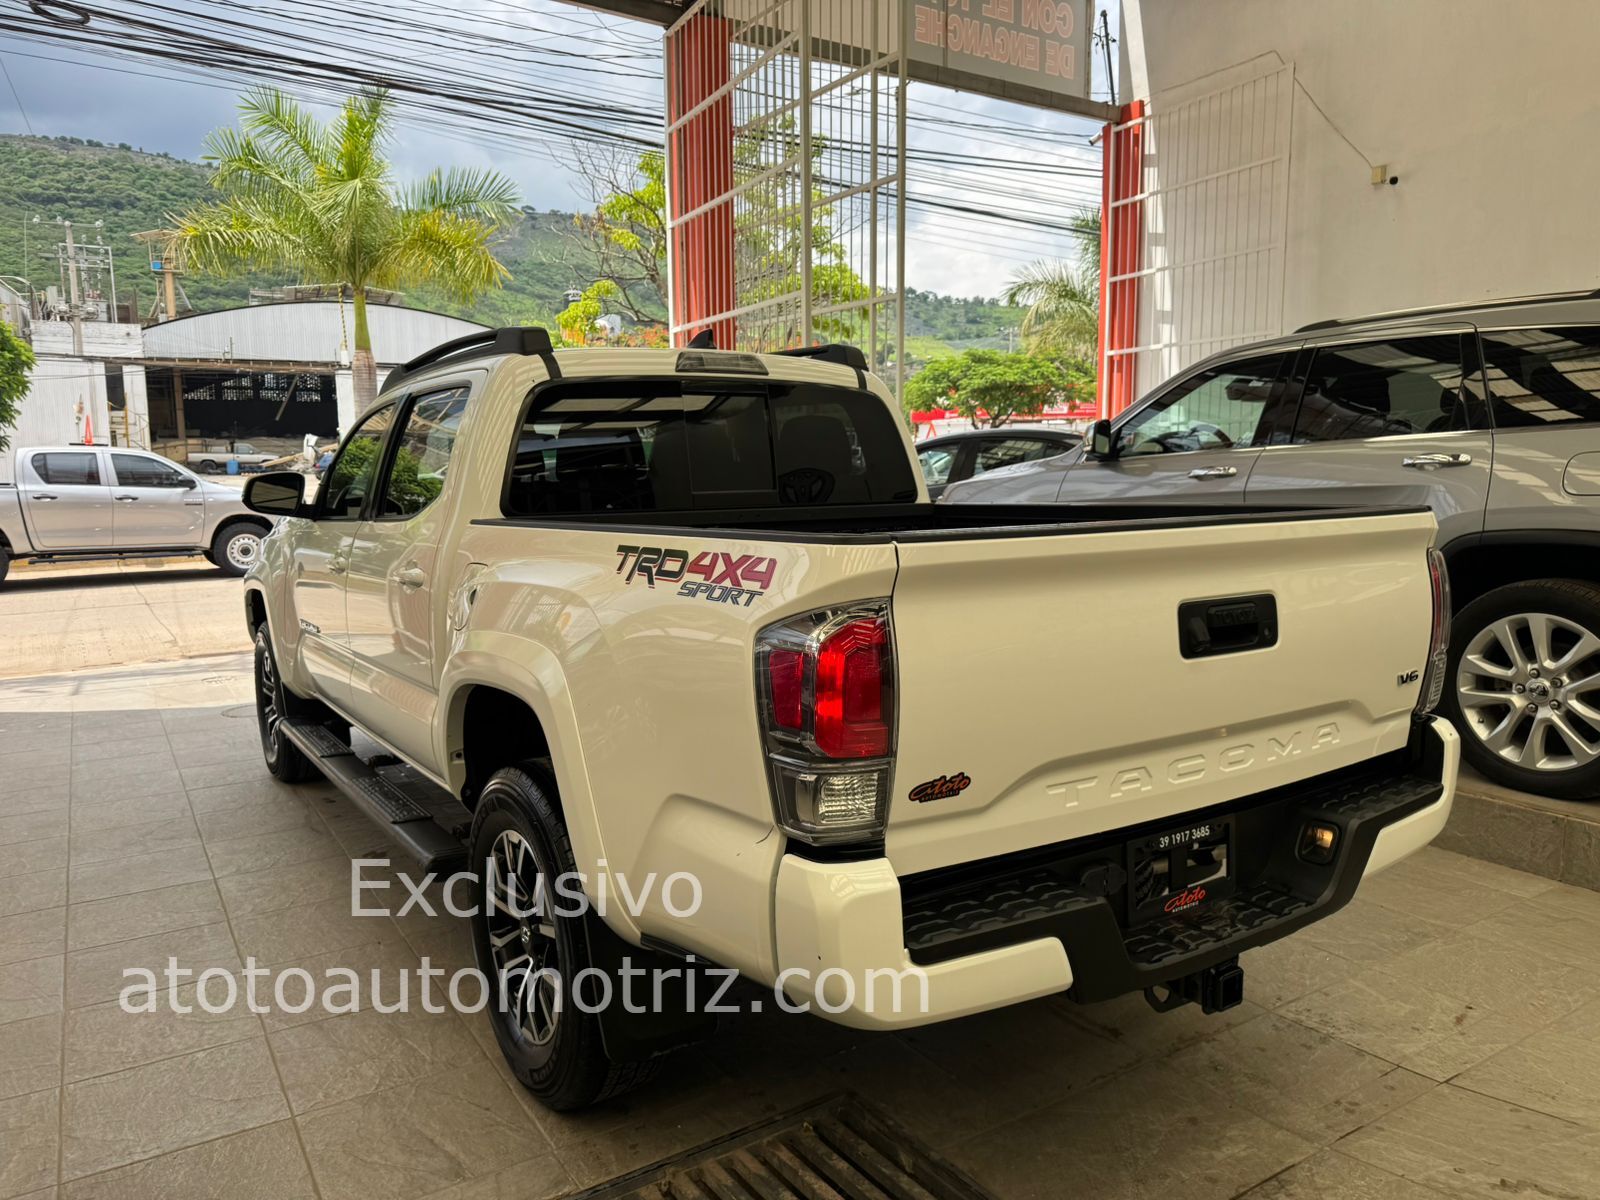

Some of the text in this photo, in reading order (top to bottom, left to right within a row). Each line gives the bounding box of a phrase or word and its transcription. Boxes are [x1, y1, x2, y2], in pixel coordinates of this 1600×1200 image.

[616, 545, 690, 589] TRD
[676, 581, 764, 607] SPORT
[1397, 670, 1419, 687] V6
[1046, 721, 1342, 808] TACOMA
[1159, 824, 1210, 848] 39 1917 3685
